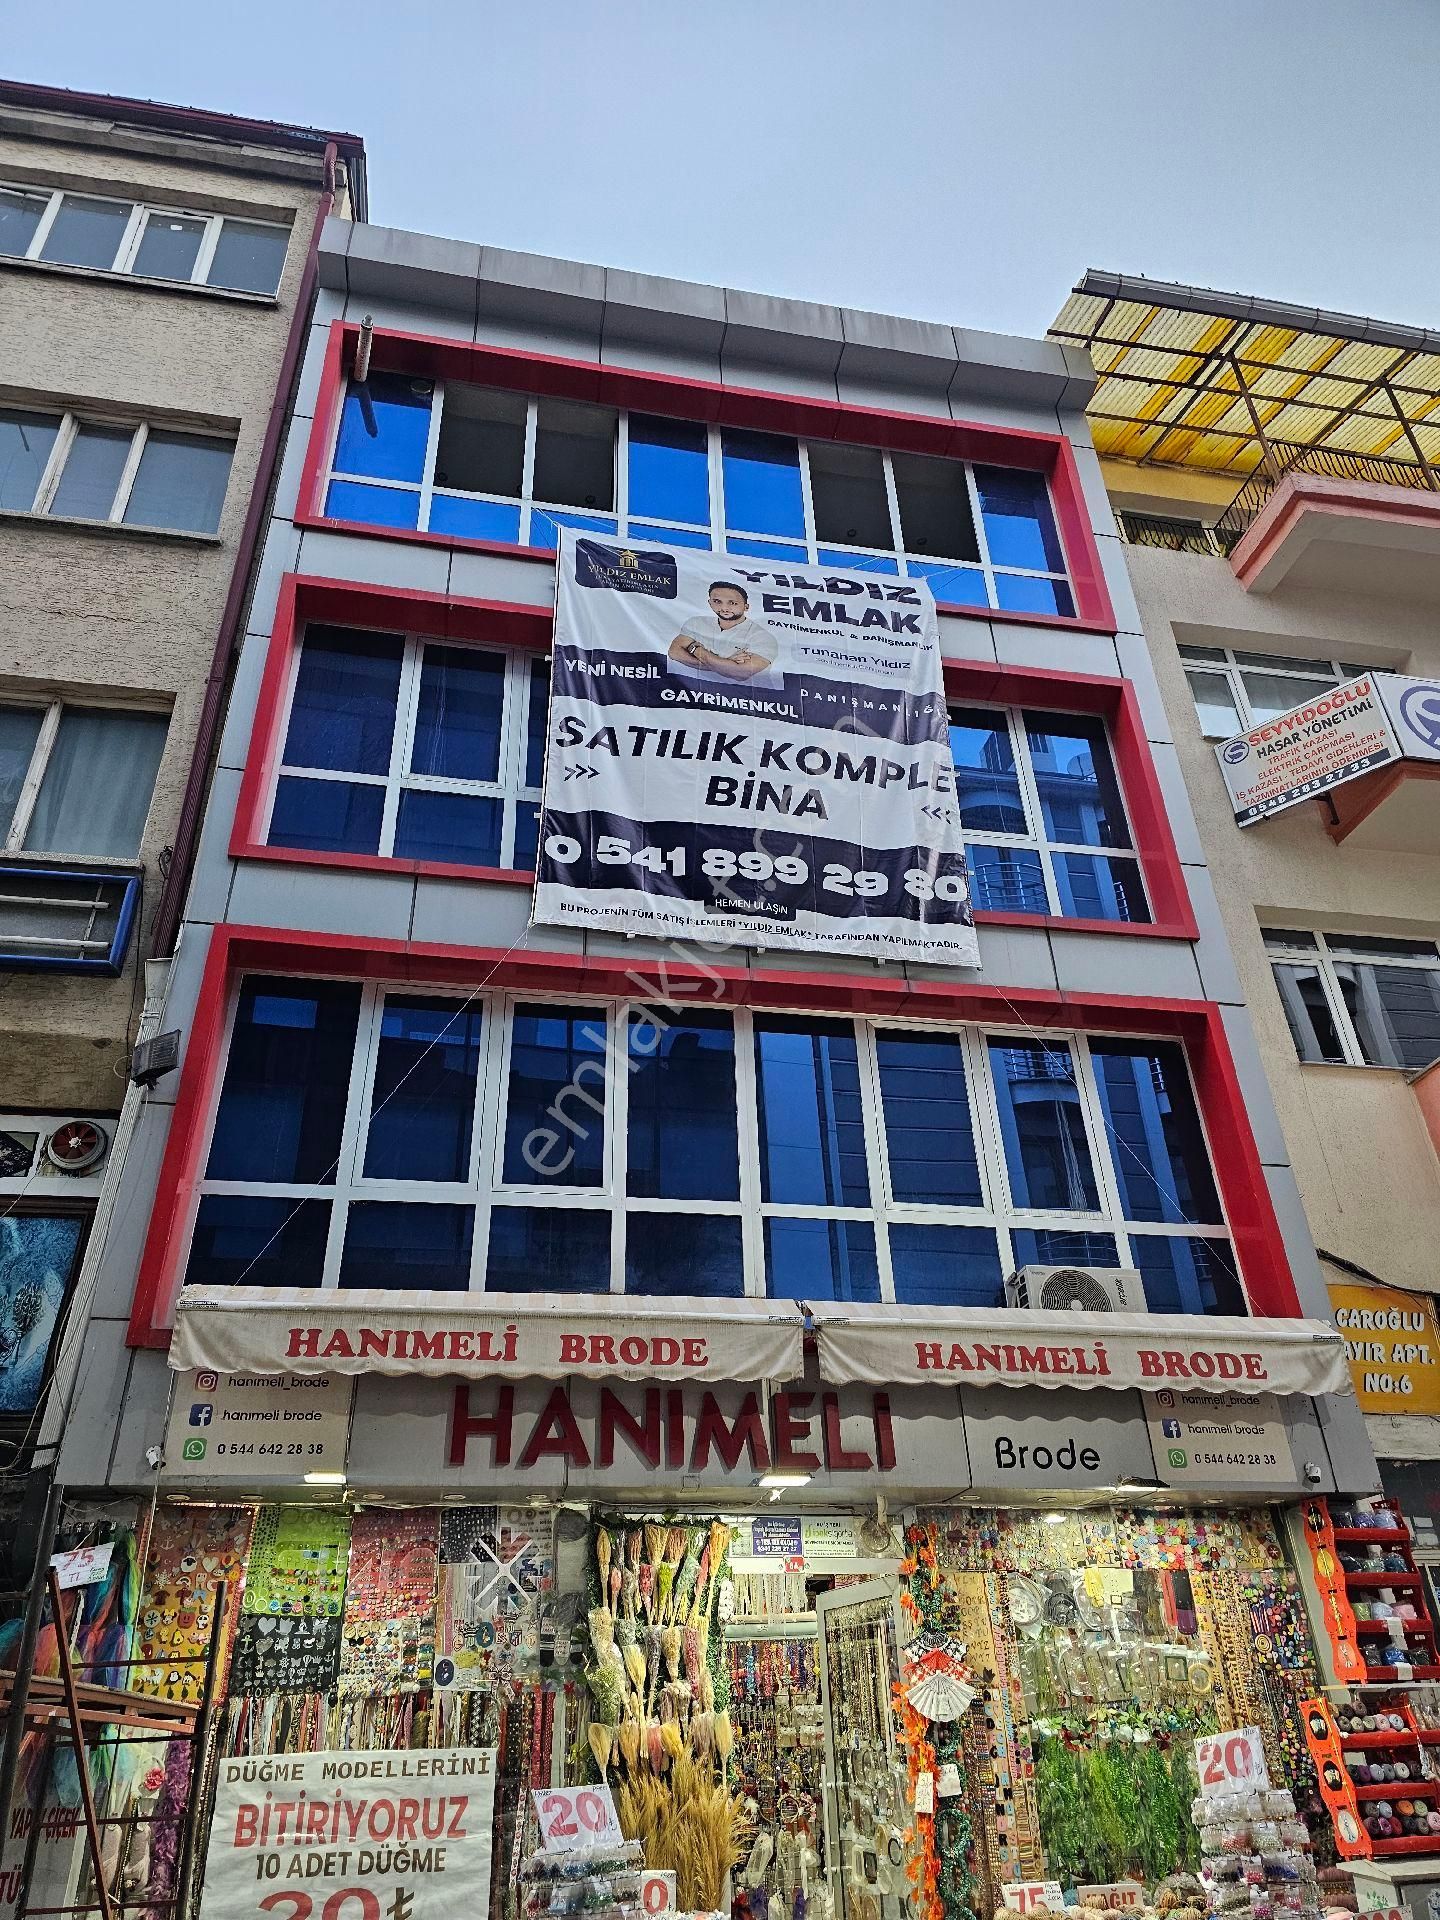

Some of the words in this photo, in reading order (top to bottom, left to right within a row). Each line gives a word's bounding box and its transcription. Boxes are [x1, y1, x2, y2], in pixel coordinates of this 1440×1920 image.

[588, 564, 627, 578] YILDIZ
[630, 572, 671, 585] EMLAK
[730, 568, 922, 605] YILDIZ
[762, 593, 923, 634] EMLAK
[768, 619, 845, 637] GAYRİMENKUL
[565, 659, 606, 676] YENİ
[611, 663, 661, 679] NESİL
[801, 647, 867, 663] Tunahan
[871, 656, 911, 669] Yıldız
[660, 688, 798, 718] GAYRİMENKUL
[555, 715, 749, 765] SATILIK
[759, 739, 951, 792] KOMPLE
[1256, 732, 1302, 758] HASAR
[1247, 775, 1283, 795] KAZASI
[1379, 729, 1386, 737] &
[1326, 768, 1344, 783] 27
[705, 770, 828, 821] BİNA
[545, 835, 581, 864] 0
[597, 836, 686, 877] 541
[702, 849, 808, 885] 899
[823, 864, 888, 896] 29
[903, 868, 966, 902] 80
[715, 899, 751, 909] HEMEN
[560, 902, 574, 912] BU
[576, 906, 629, 916] PROJENİN
[632, 908, 653, 920] TÜM
[657, 912, 684, 926] SATIŞ
[814, 932, 880, 942] TARAFINDAN
[285, 1324, 520, 1361] HANIMELİ
[559, 1334, 709, 1366] BRODE
[1392, 1343, 1435, 1365] APT.
[914, 1342, 1111, 1375] HANIMELİ
[1137, 1350, 1268, 1380] BRODE
[1364, 1373, 1413, 1394] NO:6
[284, 1410, 322, 1421] brode
[1234, 1424, 1265, 1435] brode
[217, 1443, 226, 1455] 0
[230, 1443, 254, 1455] 544
[259, 1443, 283, 1455] 642
[287, 1443, 303, 1455] 28
[307, 1443, 324, 1455] 38
[994, 1436, 1100, 1471] Brode
[1194, 1453, 1202, 1464] 0
[1204, 1453, 1224, 1464] 544
[1226, 1453, 1246, 1465] 642
[1247, 1453, 1261, 1465] 28
[1263, 1453, 1277, 1465] 38
[63, 1547, 96, 1571] 75
[225, 1759, 304, 1784] DÜĞME
[322, 1752, 491, 1780] MODELLERİNİ
[1199, 1737, 1253, 1785] 20
[234, 1789, 470, 1848] BİTİRİYORUZ
[542, 1792, 608, 1837] 20
[256, 1854, 279, 1880] 10
[287, 1851, 351, 1879] ADET
[357, 1841, 446, 1876] DÜĞME
